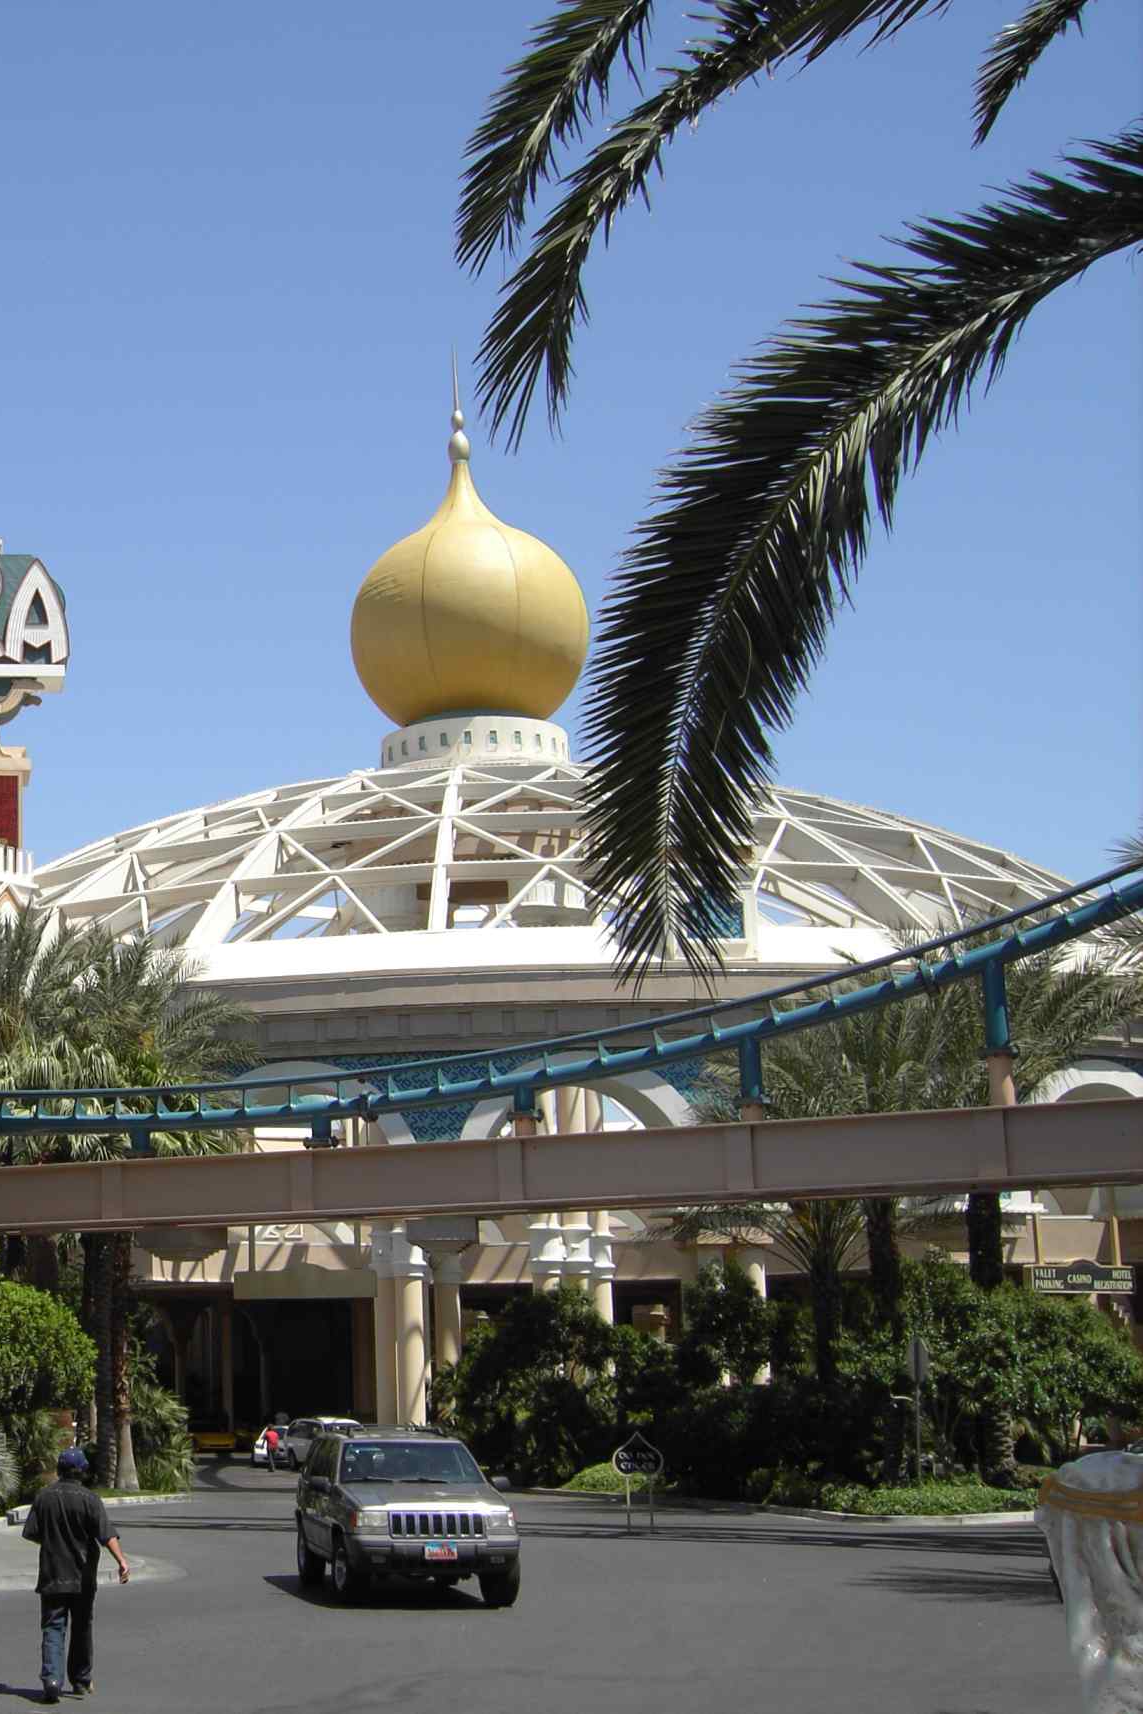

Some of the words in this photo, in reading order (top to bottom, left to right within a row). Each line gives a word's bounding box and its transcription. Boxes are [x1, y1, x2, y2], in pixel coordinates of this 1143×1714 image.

[1035, 1269, 1056, 1278] VALET
[1112, 1270, 1132, 1279] HOTEL
[1067, 1274, 1092, 1284] CASINO
[1035, 1280, 1065, 1289] PARKING
